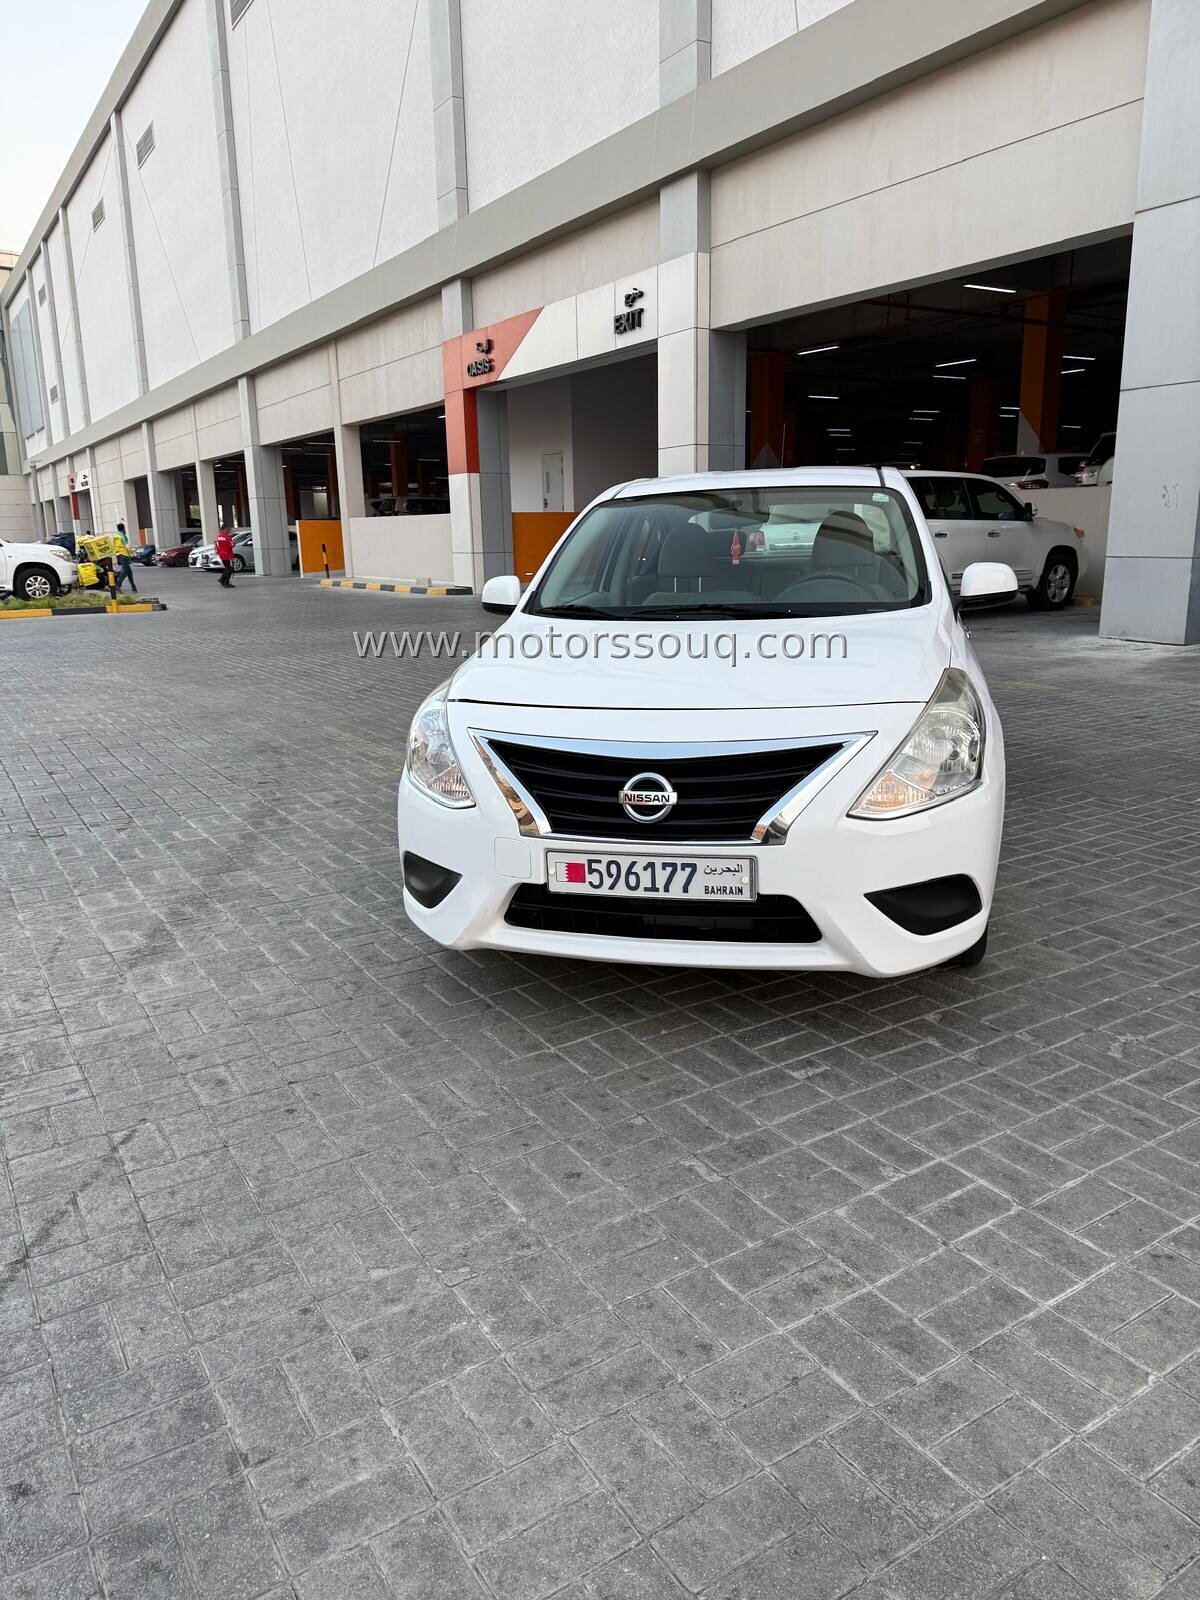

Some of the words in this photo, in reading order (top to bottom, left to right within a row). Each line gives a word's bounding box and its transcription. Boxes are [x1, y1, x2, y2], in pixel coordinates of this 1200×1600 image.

[613, 307, 644, 334] EXIT
[467, 357, 495, 377] OASIS
[624, 793, 670, 803] NISSAN
[587, 858, 698, 894] 596177
[703, 863, 743, 876] البحرين
[704, 885, 743, 896] BAHRAIN
